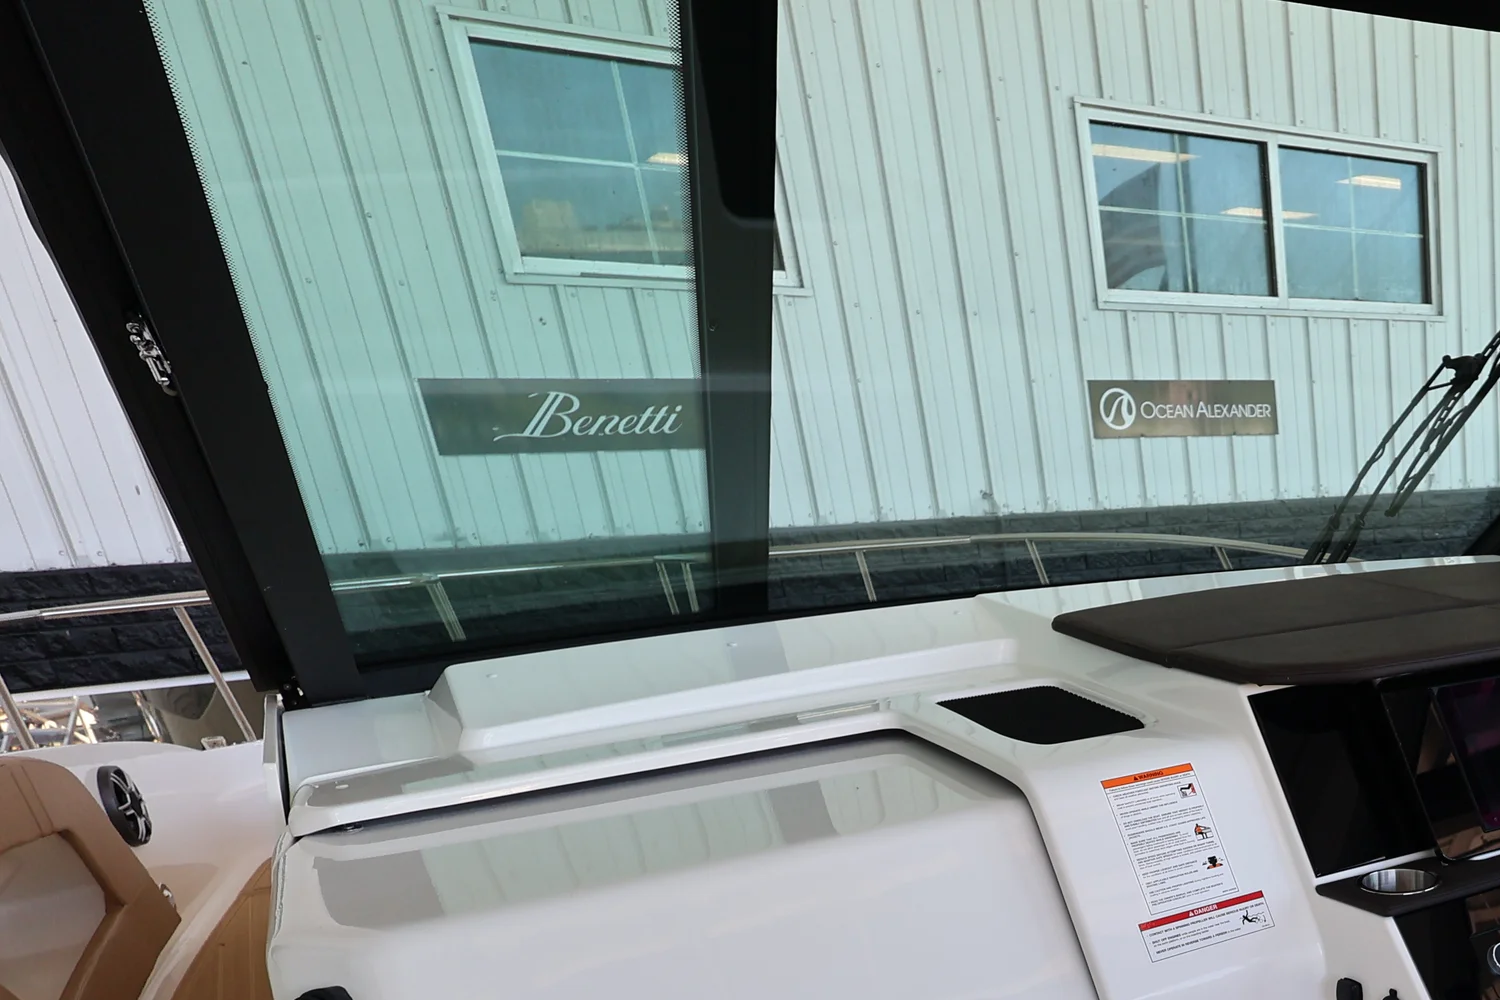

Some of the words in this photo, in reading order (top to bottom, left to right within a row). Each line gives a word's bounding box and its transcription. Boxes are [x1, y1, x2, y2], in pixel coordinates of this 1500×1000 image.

[493, 390, 683, 442] Benetti
[1138, 770, 1163, 779] WARNING
[1193, 904, 1218, 915] DANGER
